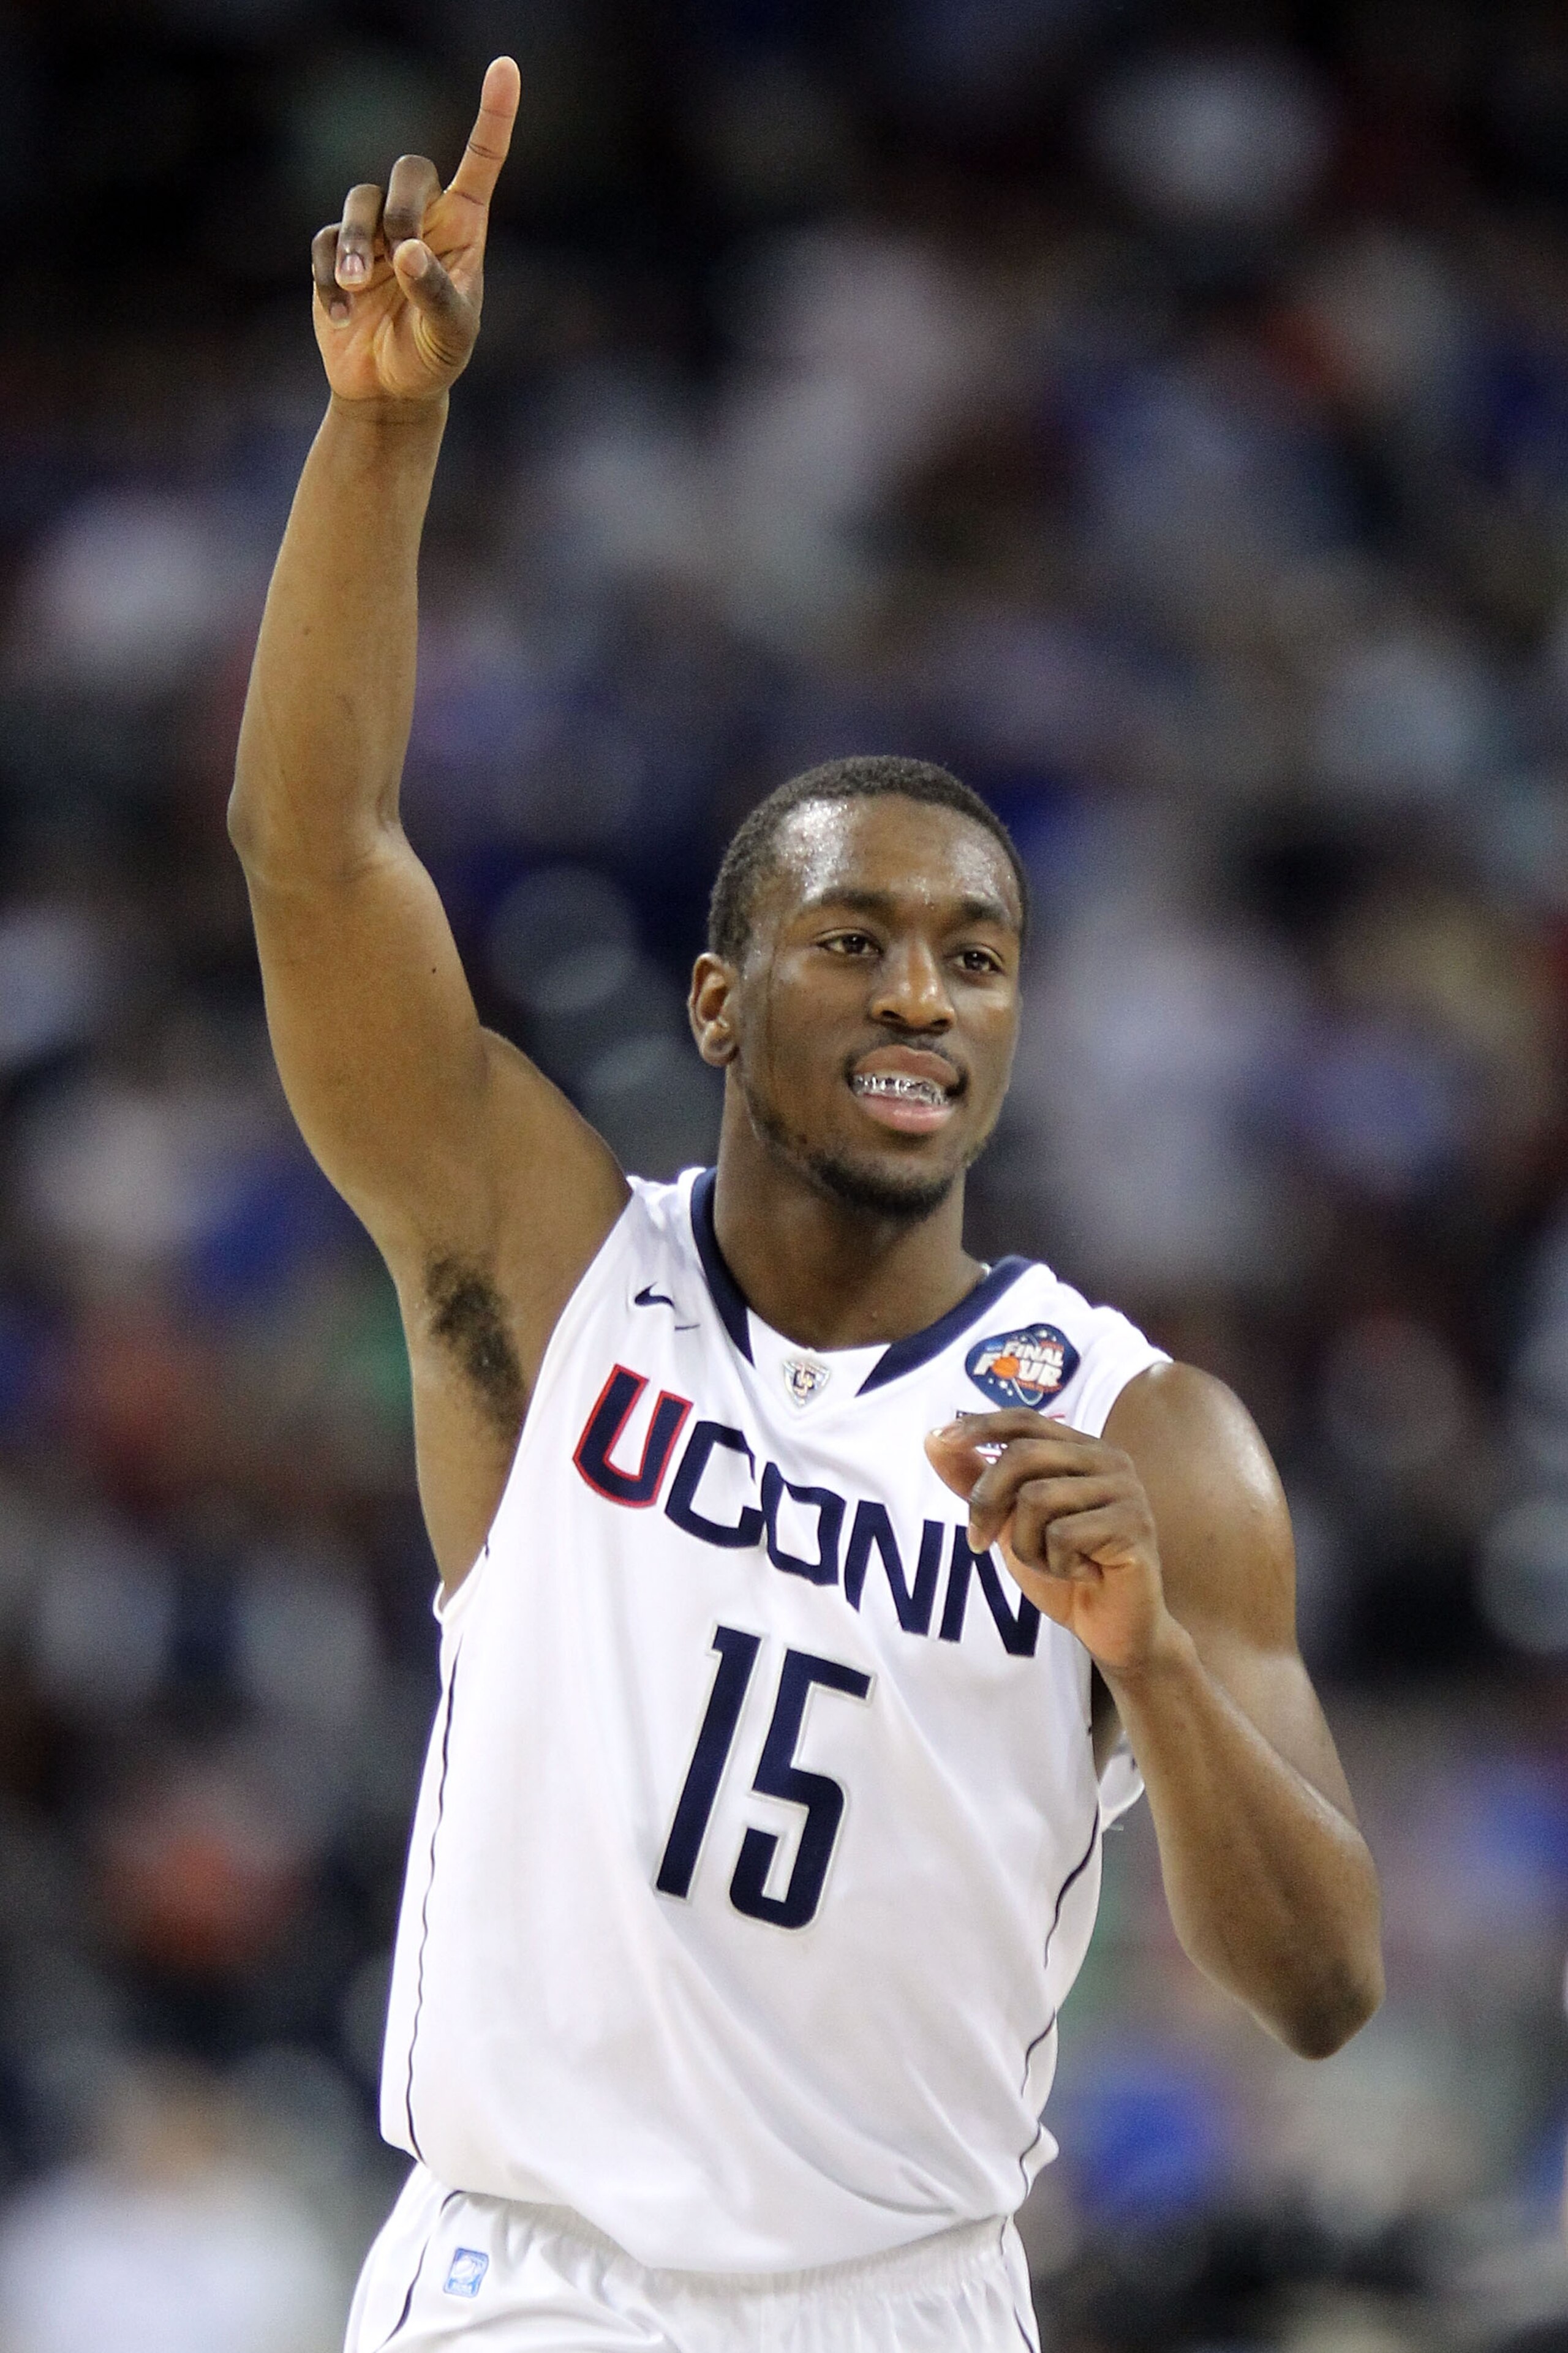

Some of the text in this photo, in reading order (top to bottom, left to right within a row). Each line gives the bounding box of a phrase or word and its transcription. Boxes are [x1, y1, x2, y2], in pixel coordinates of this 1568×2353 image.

[1003, 1340, 1063, 1366] FINAL
[572, 1363, 1041, 1657] UCONN
[652, 1623, 875, 1929] 15
